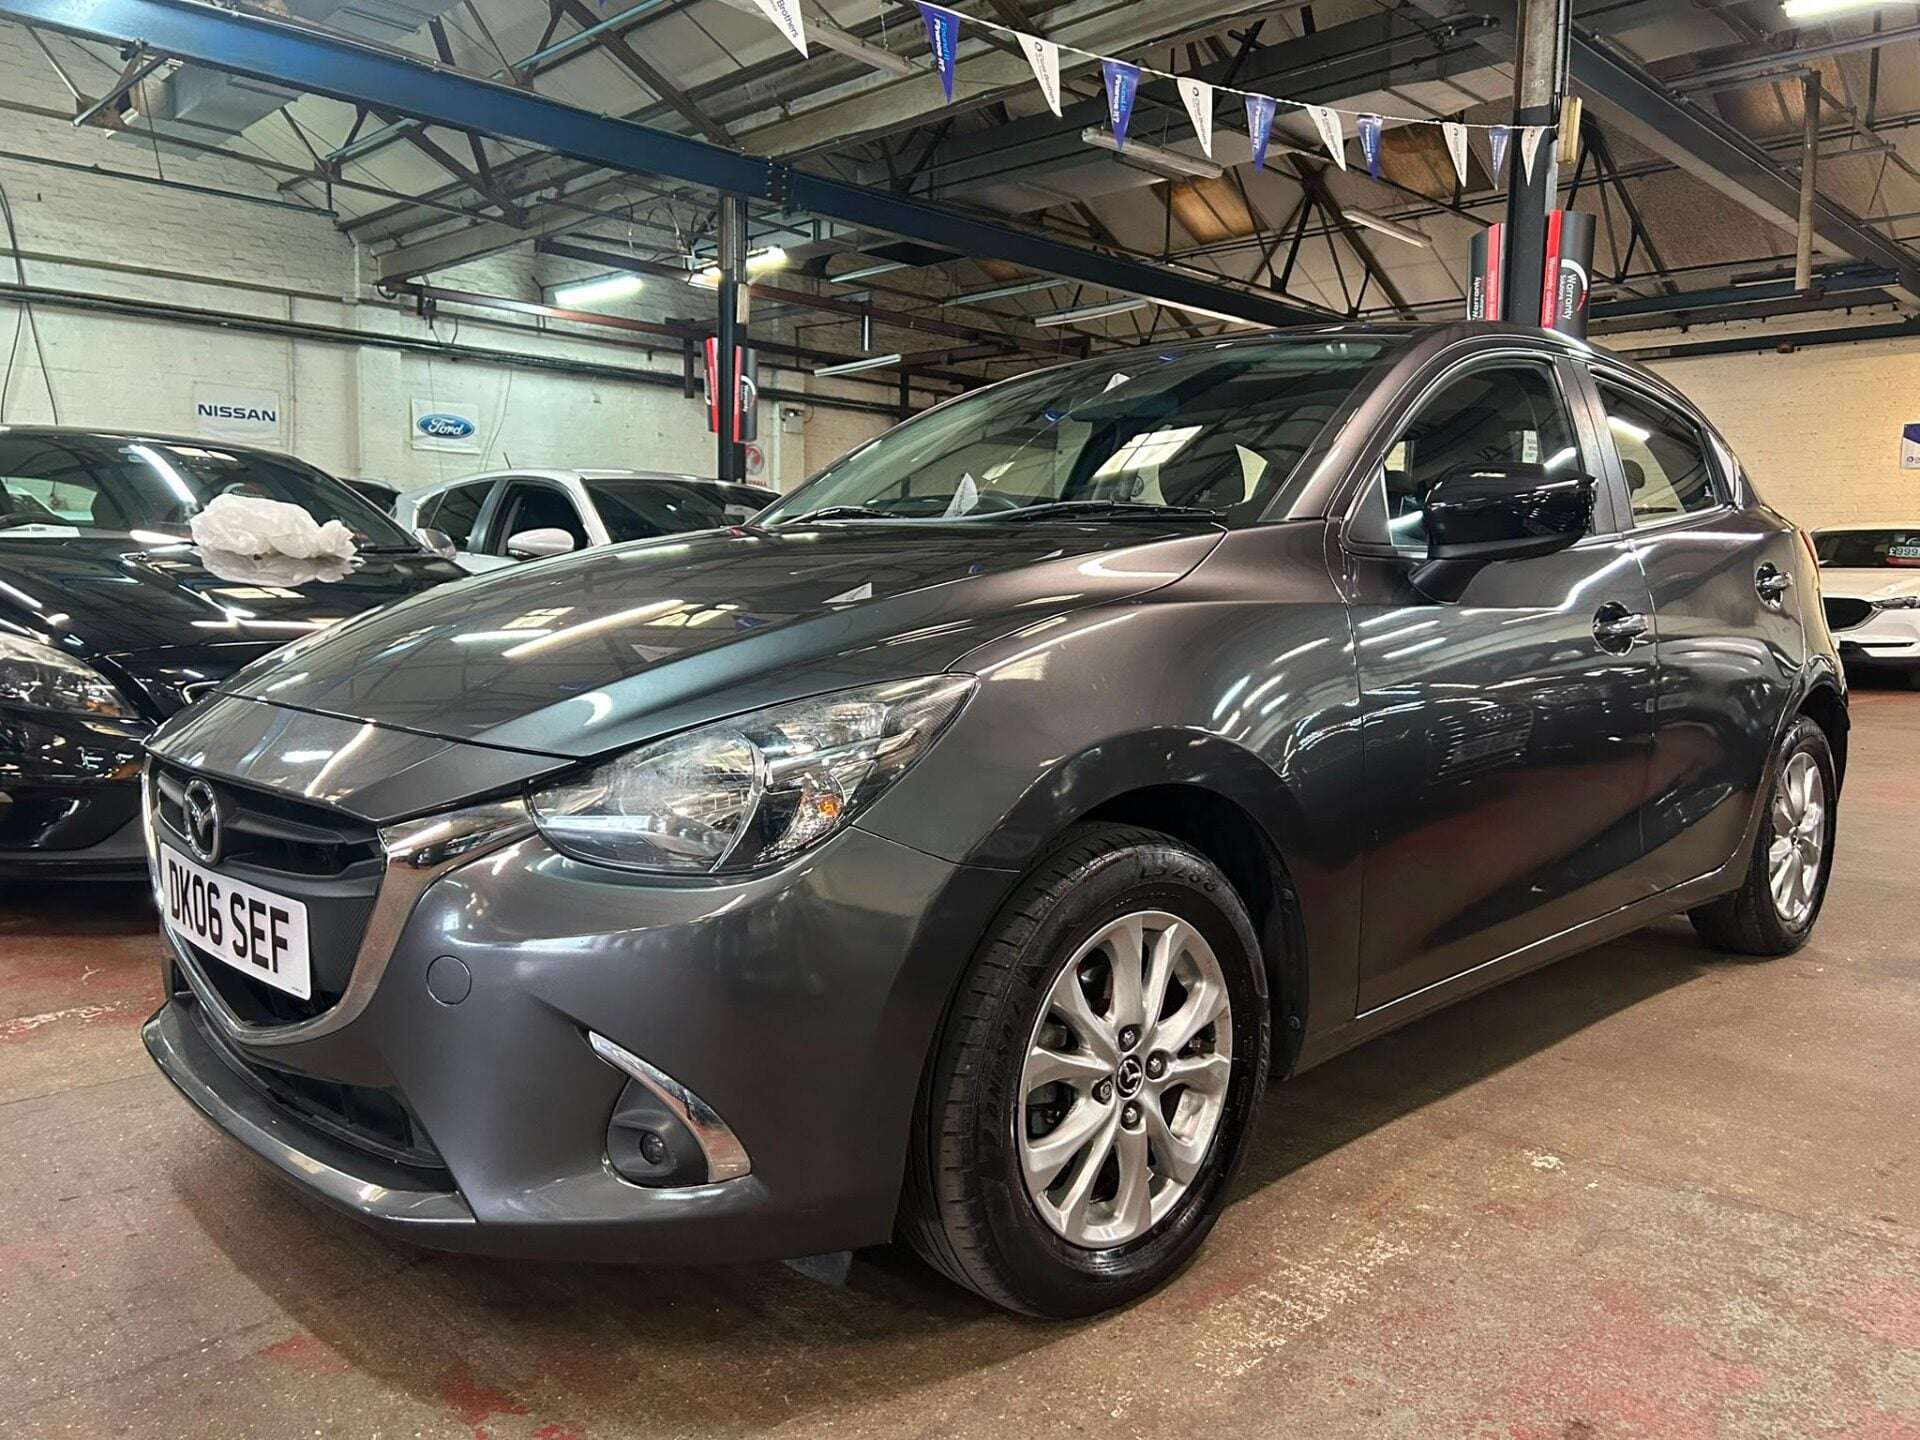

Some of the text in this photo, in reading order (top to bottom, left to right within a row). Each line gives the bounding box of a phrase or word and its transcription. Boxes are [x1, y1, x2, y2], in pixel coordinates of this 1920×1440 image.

[777, 0, 799, 38] Brothers
[934, 18, 943, 57] Finance
[1113, 73, 1122, 110] Finance
[1471, 276, 1482, 320] Warranty
[1561, 273, 1577, 320] Warranty
[198, 404, 276, 422] NISSAN
[428, 417, 465, 435] Ford
[1888, 545, 1920, 557] £999
[168, 858, 289, 974] DK06 SEF
